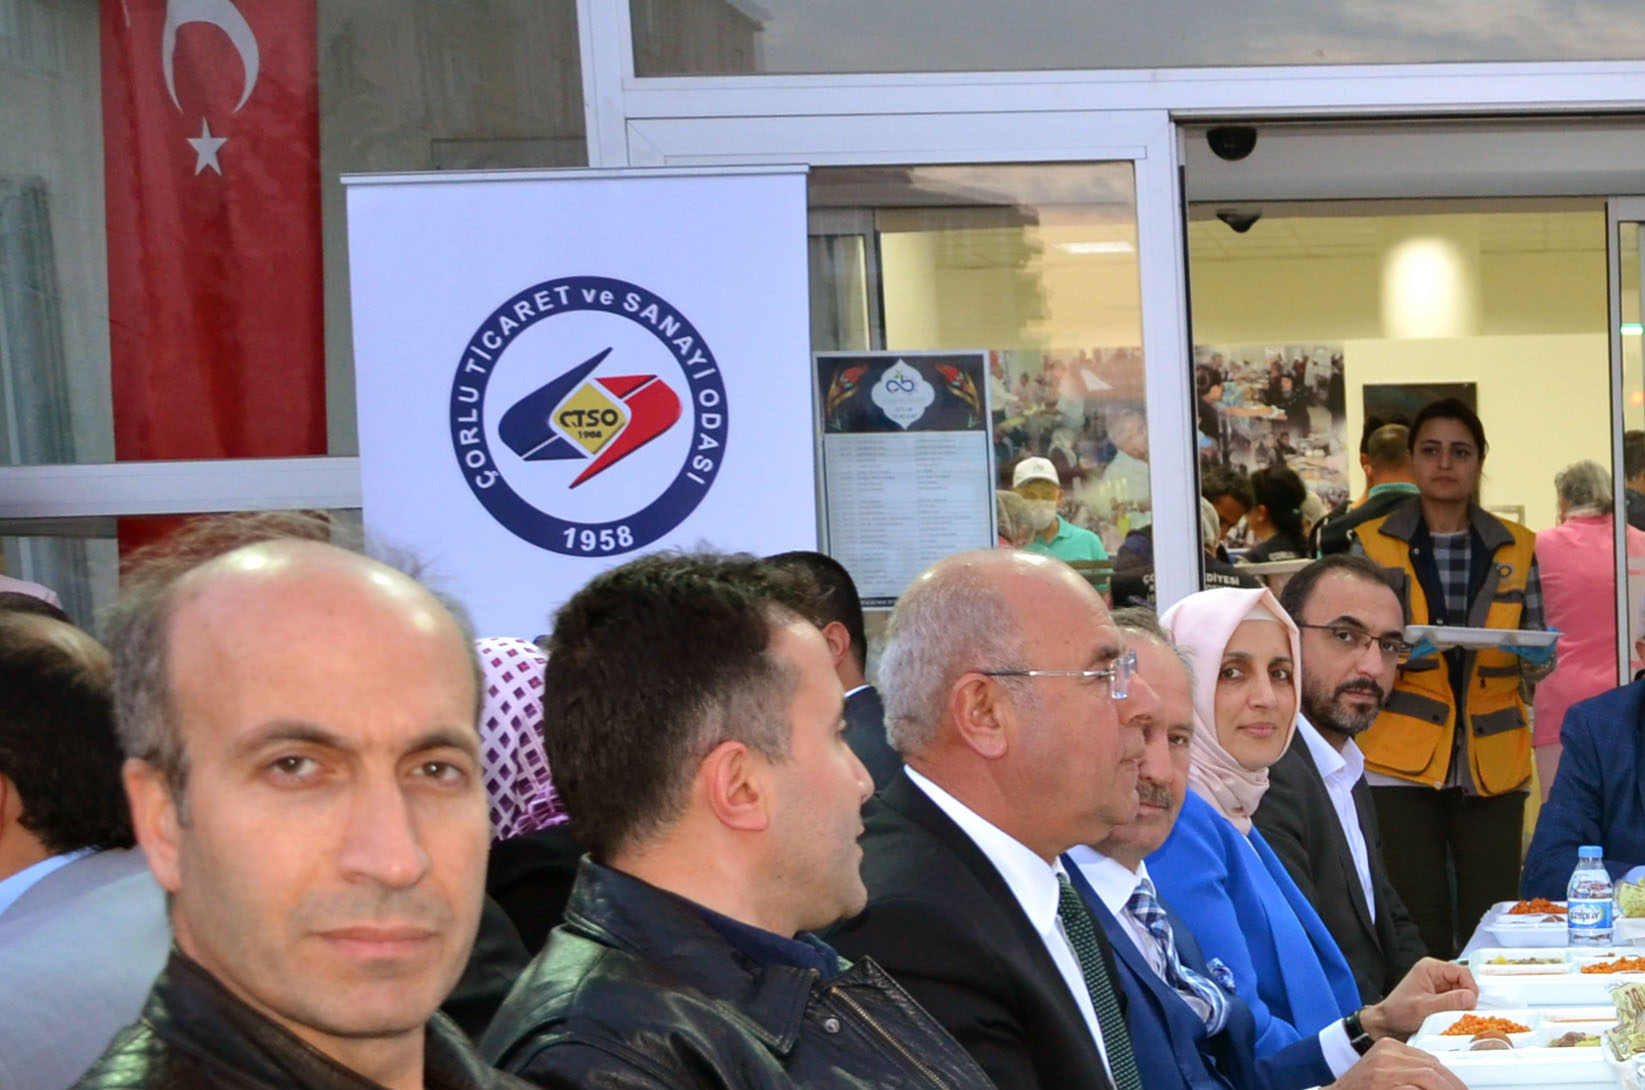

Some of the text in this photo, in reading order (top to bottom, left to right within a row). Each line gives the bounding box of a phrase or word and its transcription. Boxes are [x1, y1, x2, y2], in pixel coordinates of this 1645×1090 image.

[457, 285, 722, 489] ÇORLU TİCARET ve SANAYİ ODASI
[562, 525, 634, 551] 1958
